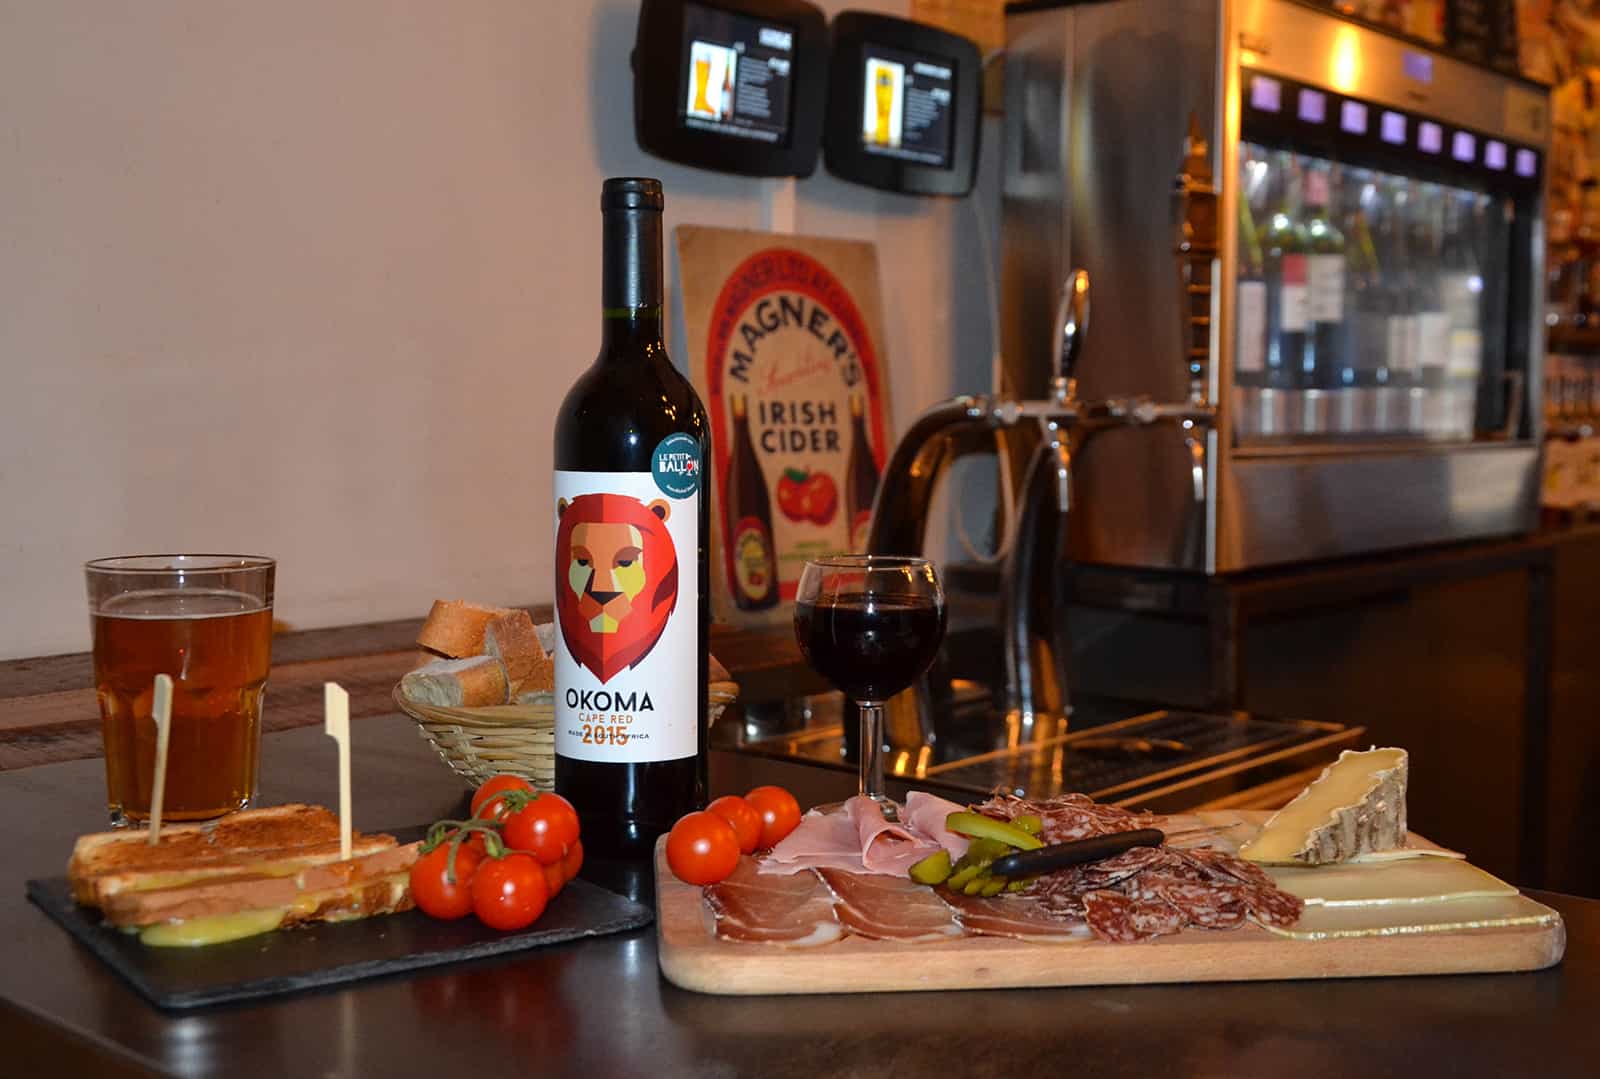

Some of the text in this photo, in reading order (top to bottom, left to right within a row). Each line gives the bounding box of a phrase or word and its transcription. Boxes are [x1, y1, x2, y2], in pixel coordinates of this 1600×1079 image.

[729, 295, 861, 388] MAGNER'S
[759, 401, 838, 425] IRISH
[761, 428, 840, 453] CIDER
[566, 688, 654, 712] OKOMA
[578, 712, 633, 724] CAPE RED
[582, 724, 629, 745] 2015
